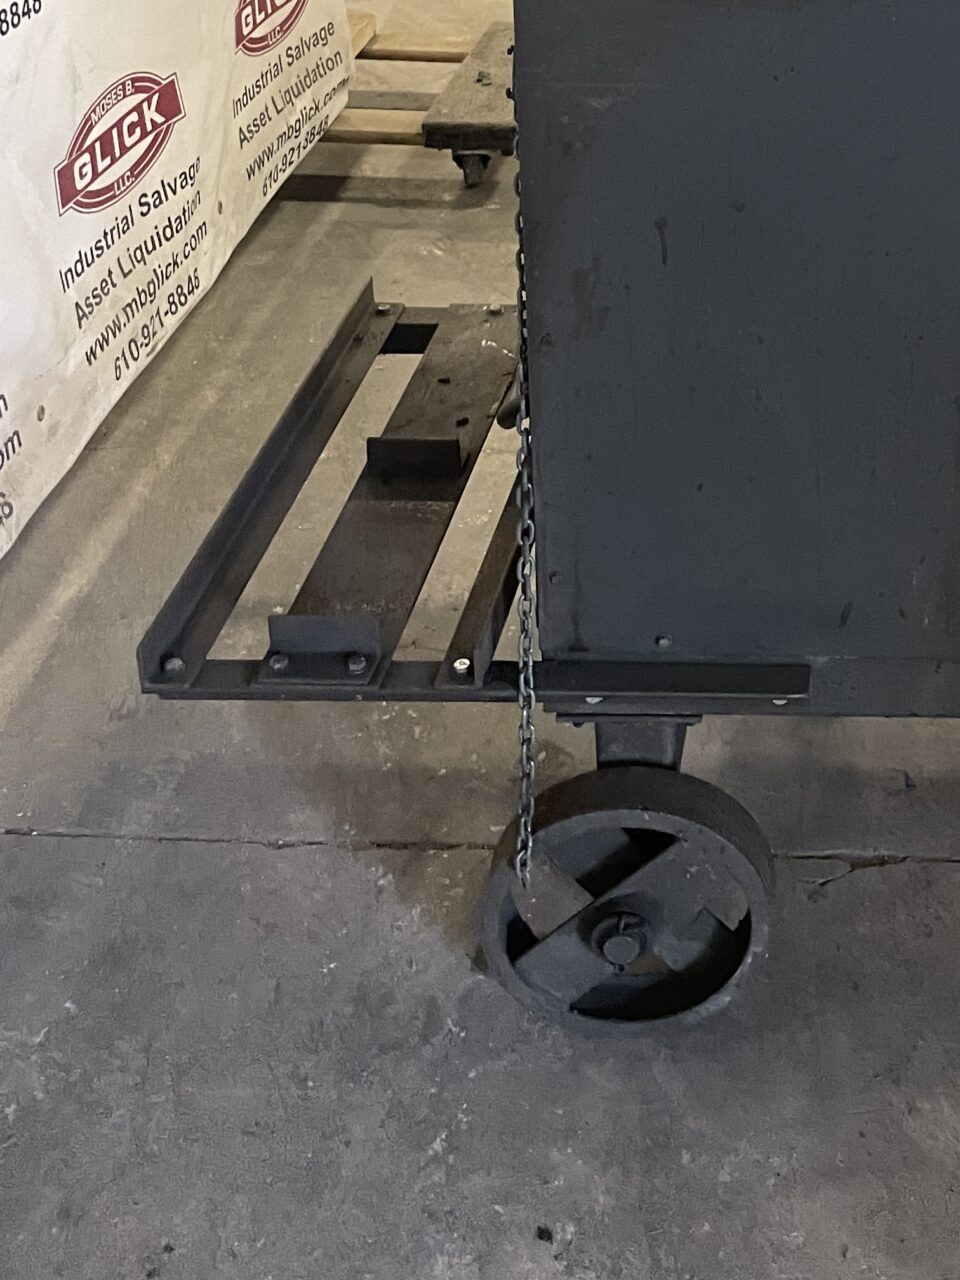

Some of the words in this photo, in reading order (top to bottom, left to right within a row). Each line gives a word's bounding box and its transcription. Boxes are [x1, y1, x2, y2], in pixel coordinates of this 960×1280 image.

[90, 85, 124, 126] MOSES
[232, 54, 284, 119] Industrial
[285, 21, 335, 68] Salvage
[238, 104, 273, 150] Asset
[270, 50, 343, 115] Liquidation
[73, 92, 166, 191] GLICK
[113, 170, 136, 195] LLC.
[59, 204, 135, 294] Industrial
[138, 156, 201, 218] Salvage
[75, 267, 118, 330] Asset
[117, 189, 201, 279] Liquidation
[85, 220, 208, 367] www.mbglick.com
